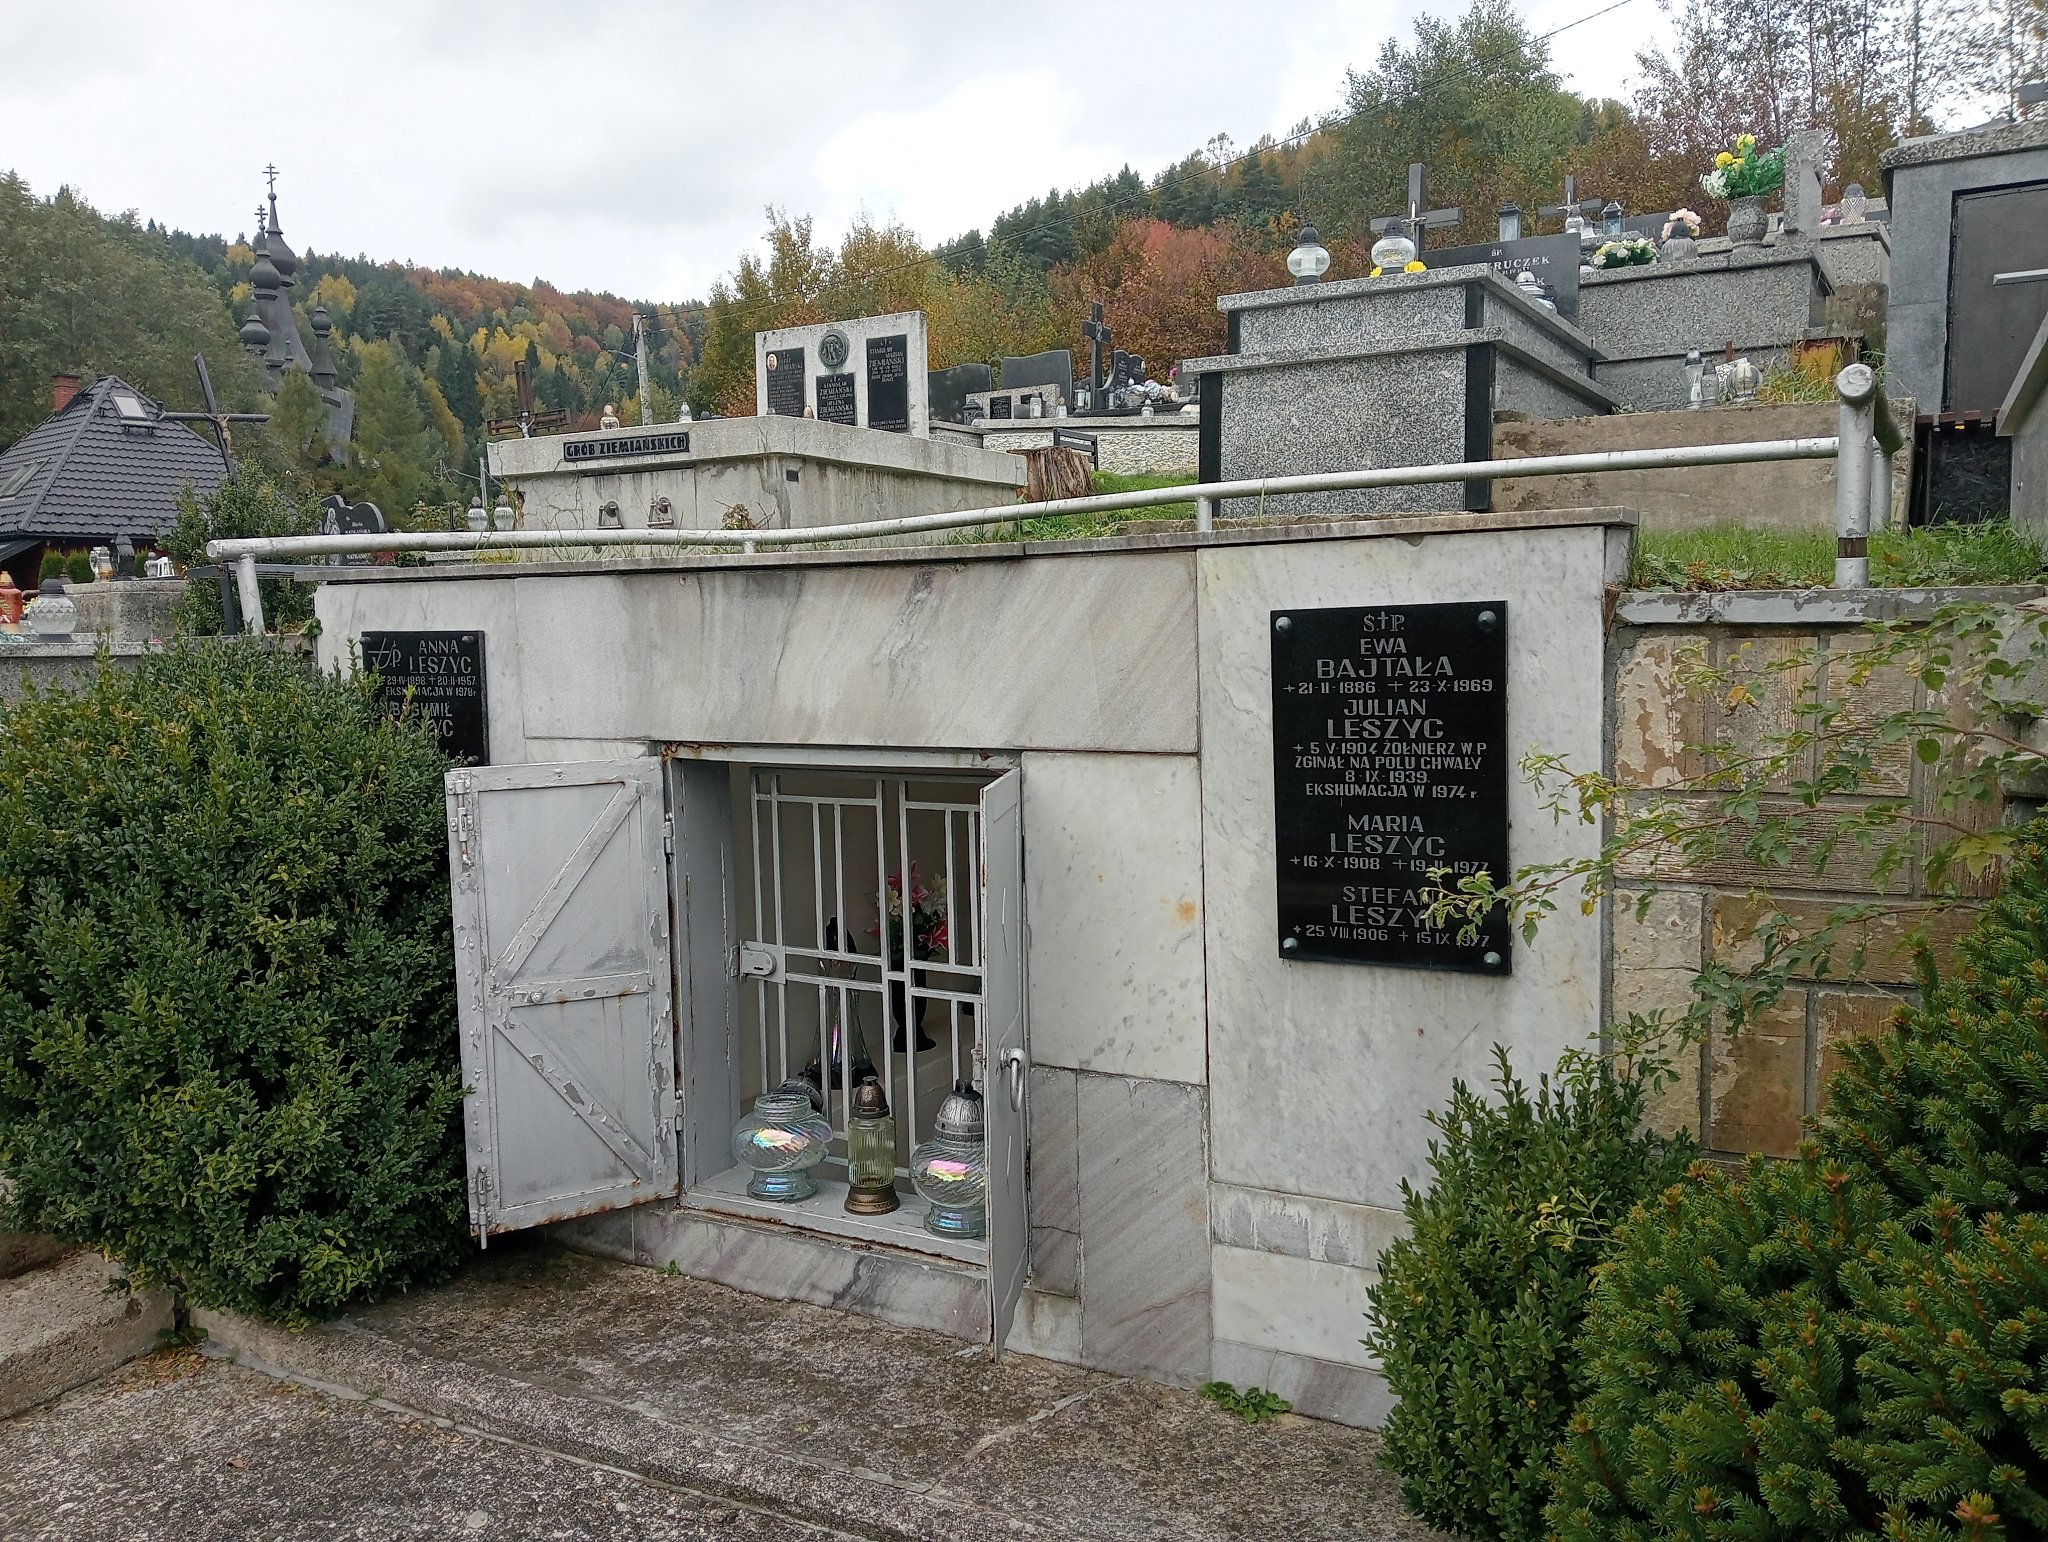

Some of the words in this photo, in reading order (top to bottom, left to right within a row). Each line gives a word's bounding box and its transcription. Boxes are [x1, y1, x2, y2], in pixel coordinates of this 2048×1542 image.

[567, 442, 595, 457] GRÓB
[599, 437, 685, 454] ZIEMIAŃSKICH
[418, 640, 459, 654] ANNA
[1360, 637, 1407, 655] EWA
[409, 656, 472, 674] LESZYC
[1316, 656, 1453, 679] BAJTAŁA
[1343, 699, 1426, 716] JULIAN
[1327, 719, 1444, 739] LESZYC
[1383, 740, 1455, 755] ŻOŁNIERZ
[1295, 756, 1345, 770] ZGINĄŁ
[1350, 756, 1370, 769] NA
[1375, 757, 1415, 770] POLU
[1420, 757, 1482, 770] CHWAŁY
[1305, 783, 1408, 798] EKSHUMACJA
[1413, 785, 1425, 798] W
[1348, 814, 1424, 833] MARIA
[1330, 833, 1446, 857] LESZYC
